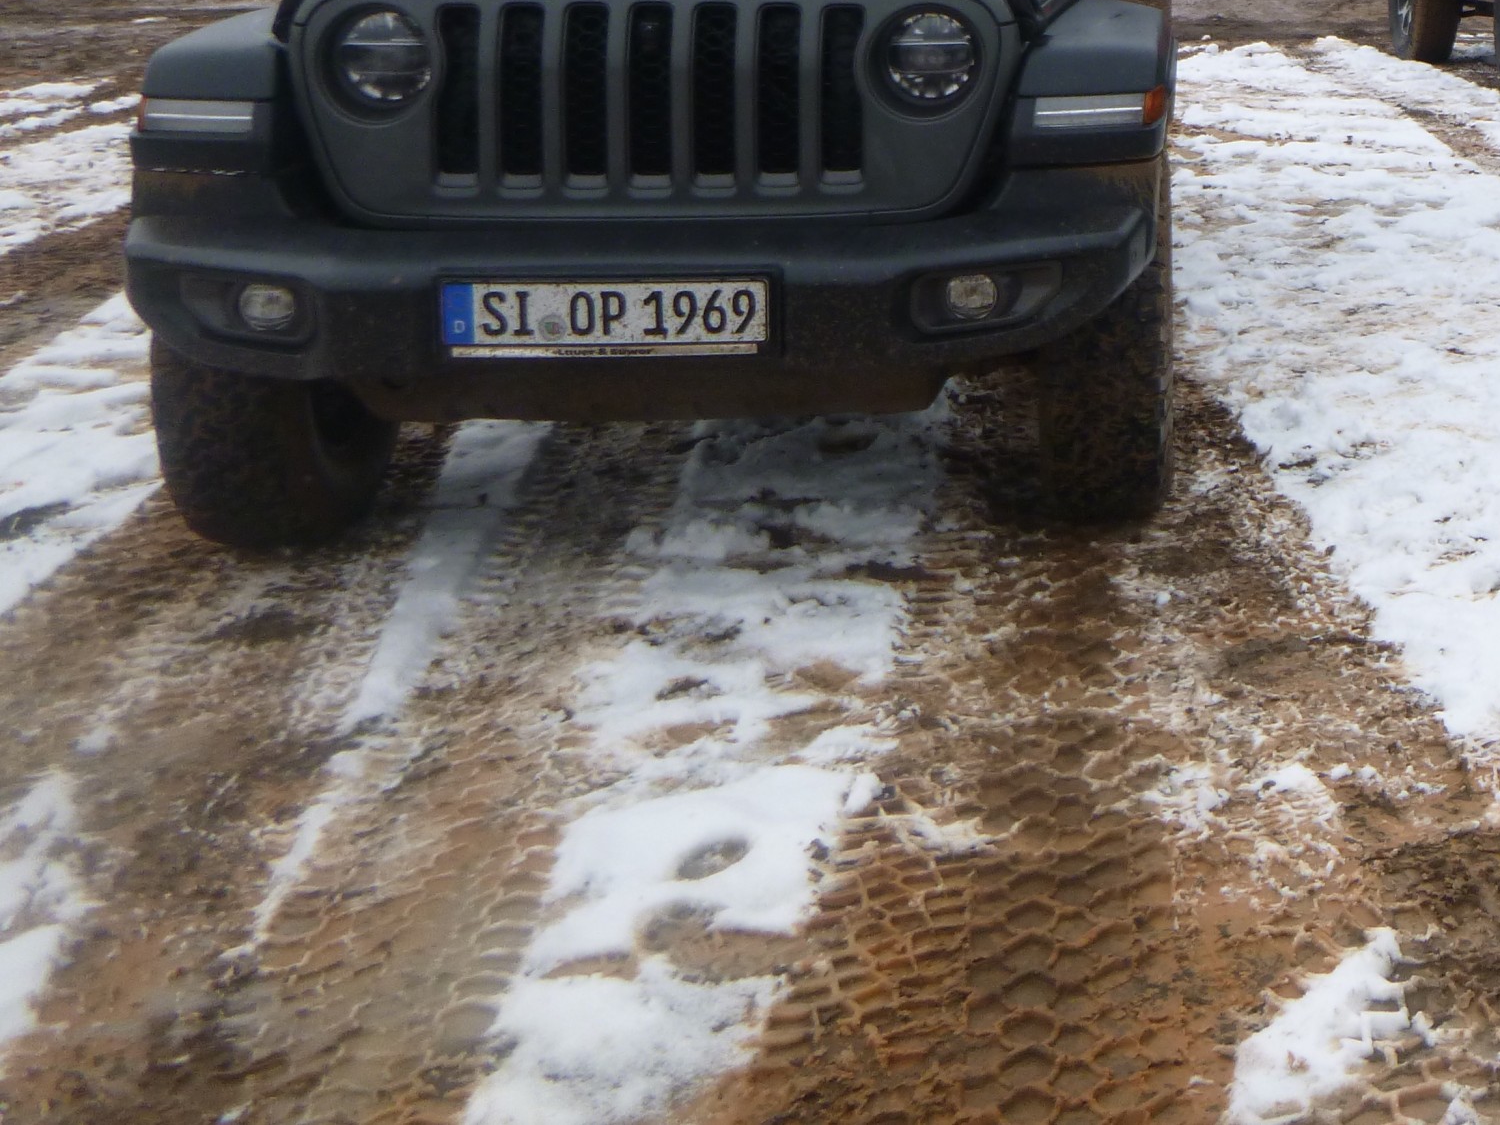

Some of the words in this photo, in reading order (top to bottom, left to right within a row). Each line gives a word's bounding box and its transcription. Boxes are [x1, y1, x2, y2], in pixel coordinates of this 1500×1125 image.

[481, 290, 535, 337] SI
[569, 290, 627, 337] OP
[643, 289, 757, 337] 1969
